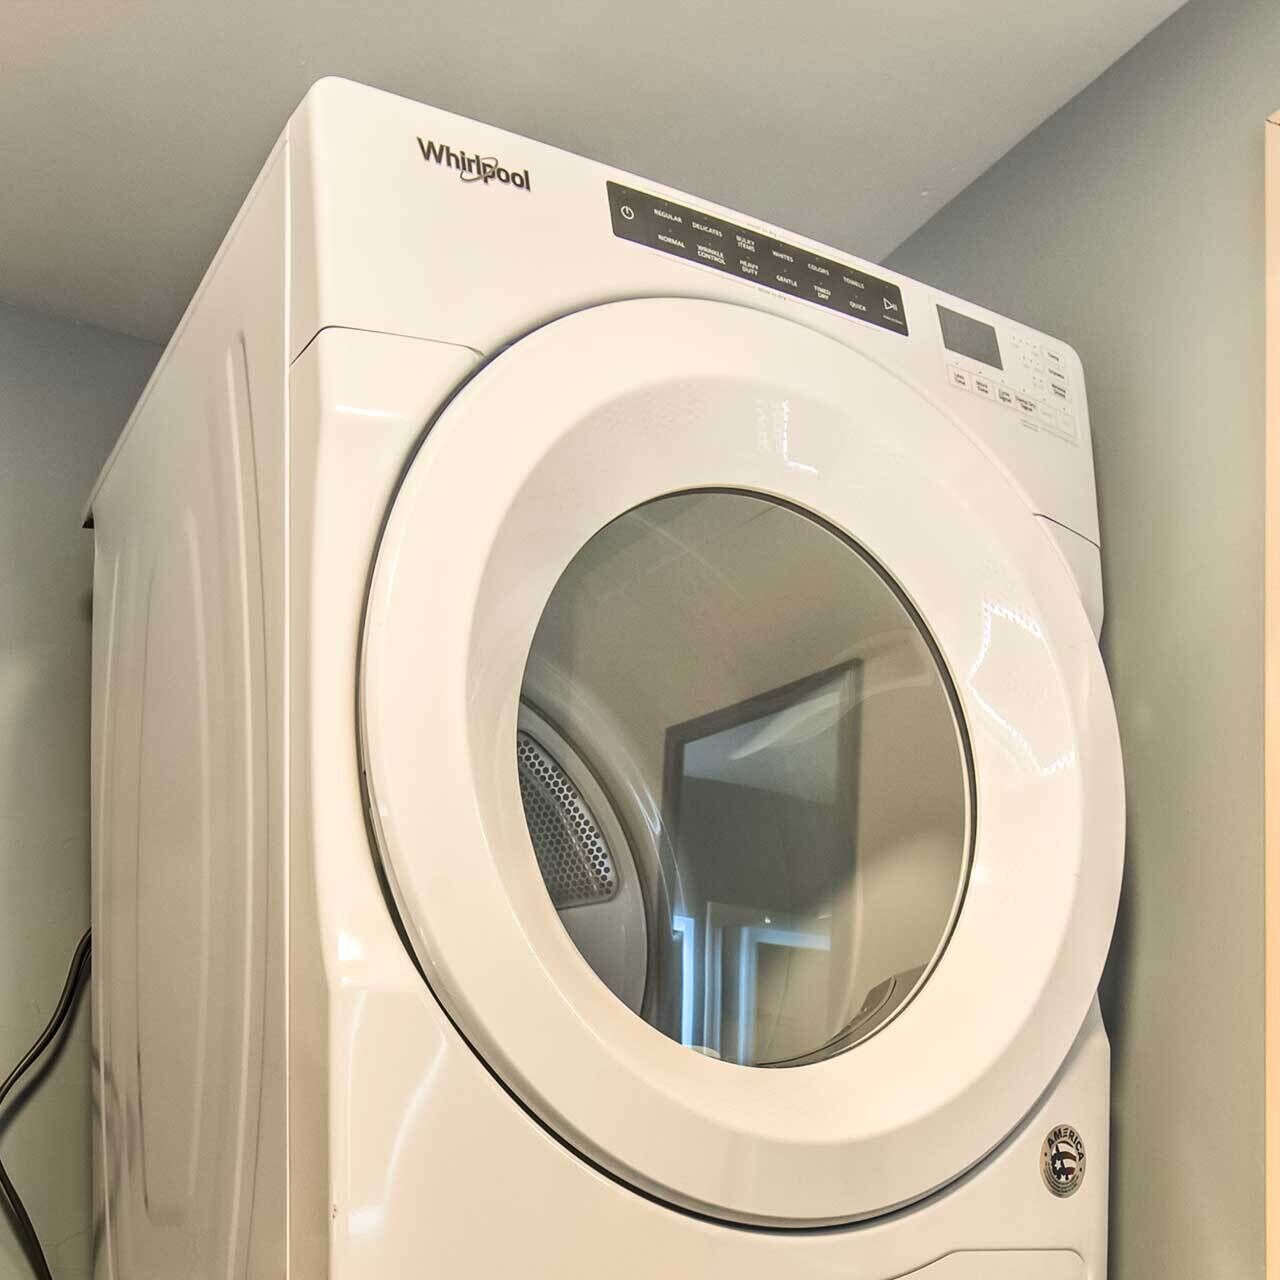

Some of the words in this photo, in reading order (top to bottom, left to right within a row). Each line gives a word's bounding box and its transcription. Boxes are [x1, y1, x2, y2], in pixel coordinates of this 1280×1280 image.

[416, 136, 531, 192] Whirlpool
[653, 209, 682, 224] REGULAR
[692, 221, 723, 238] DELICATES
[658, 234, 686, 248] NORMAL
[697, 244, 724, 258] WRINKLE
[698, 251, 726, 265] CONTROL
[772, 250, 794, 263] WHITES
[741, 266, 758, 276] DUTY
[808, 263, 830, 276] COLORS
[776, 274, 798, 288] GENTLE
[849, 300, 867, 312] QUICK
[1047, 1127, 1084, 1162] AMERICA
